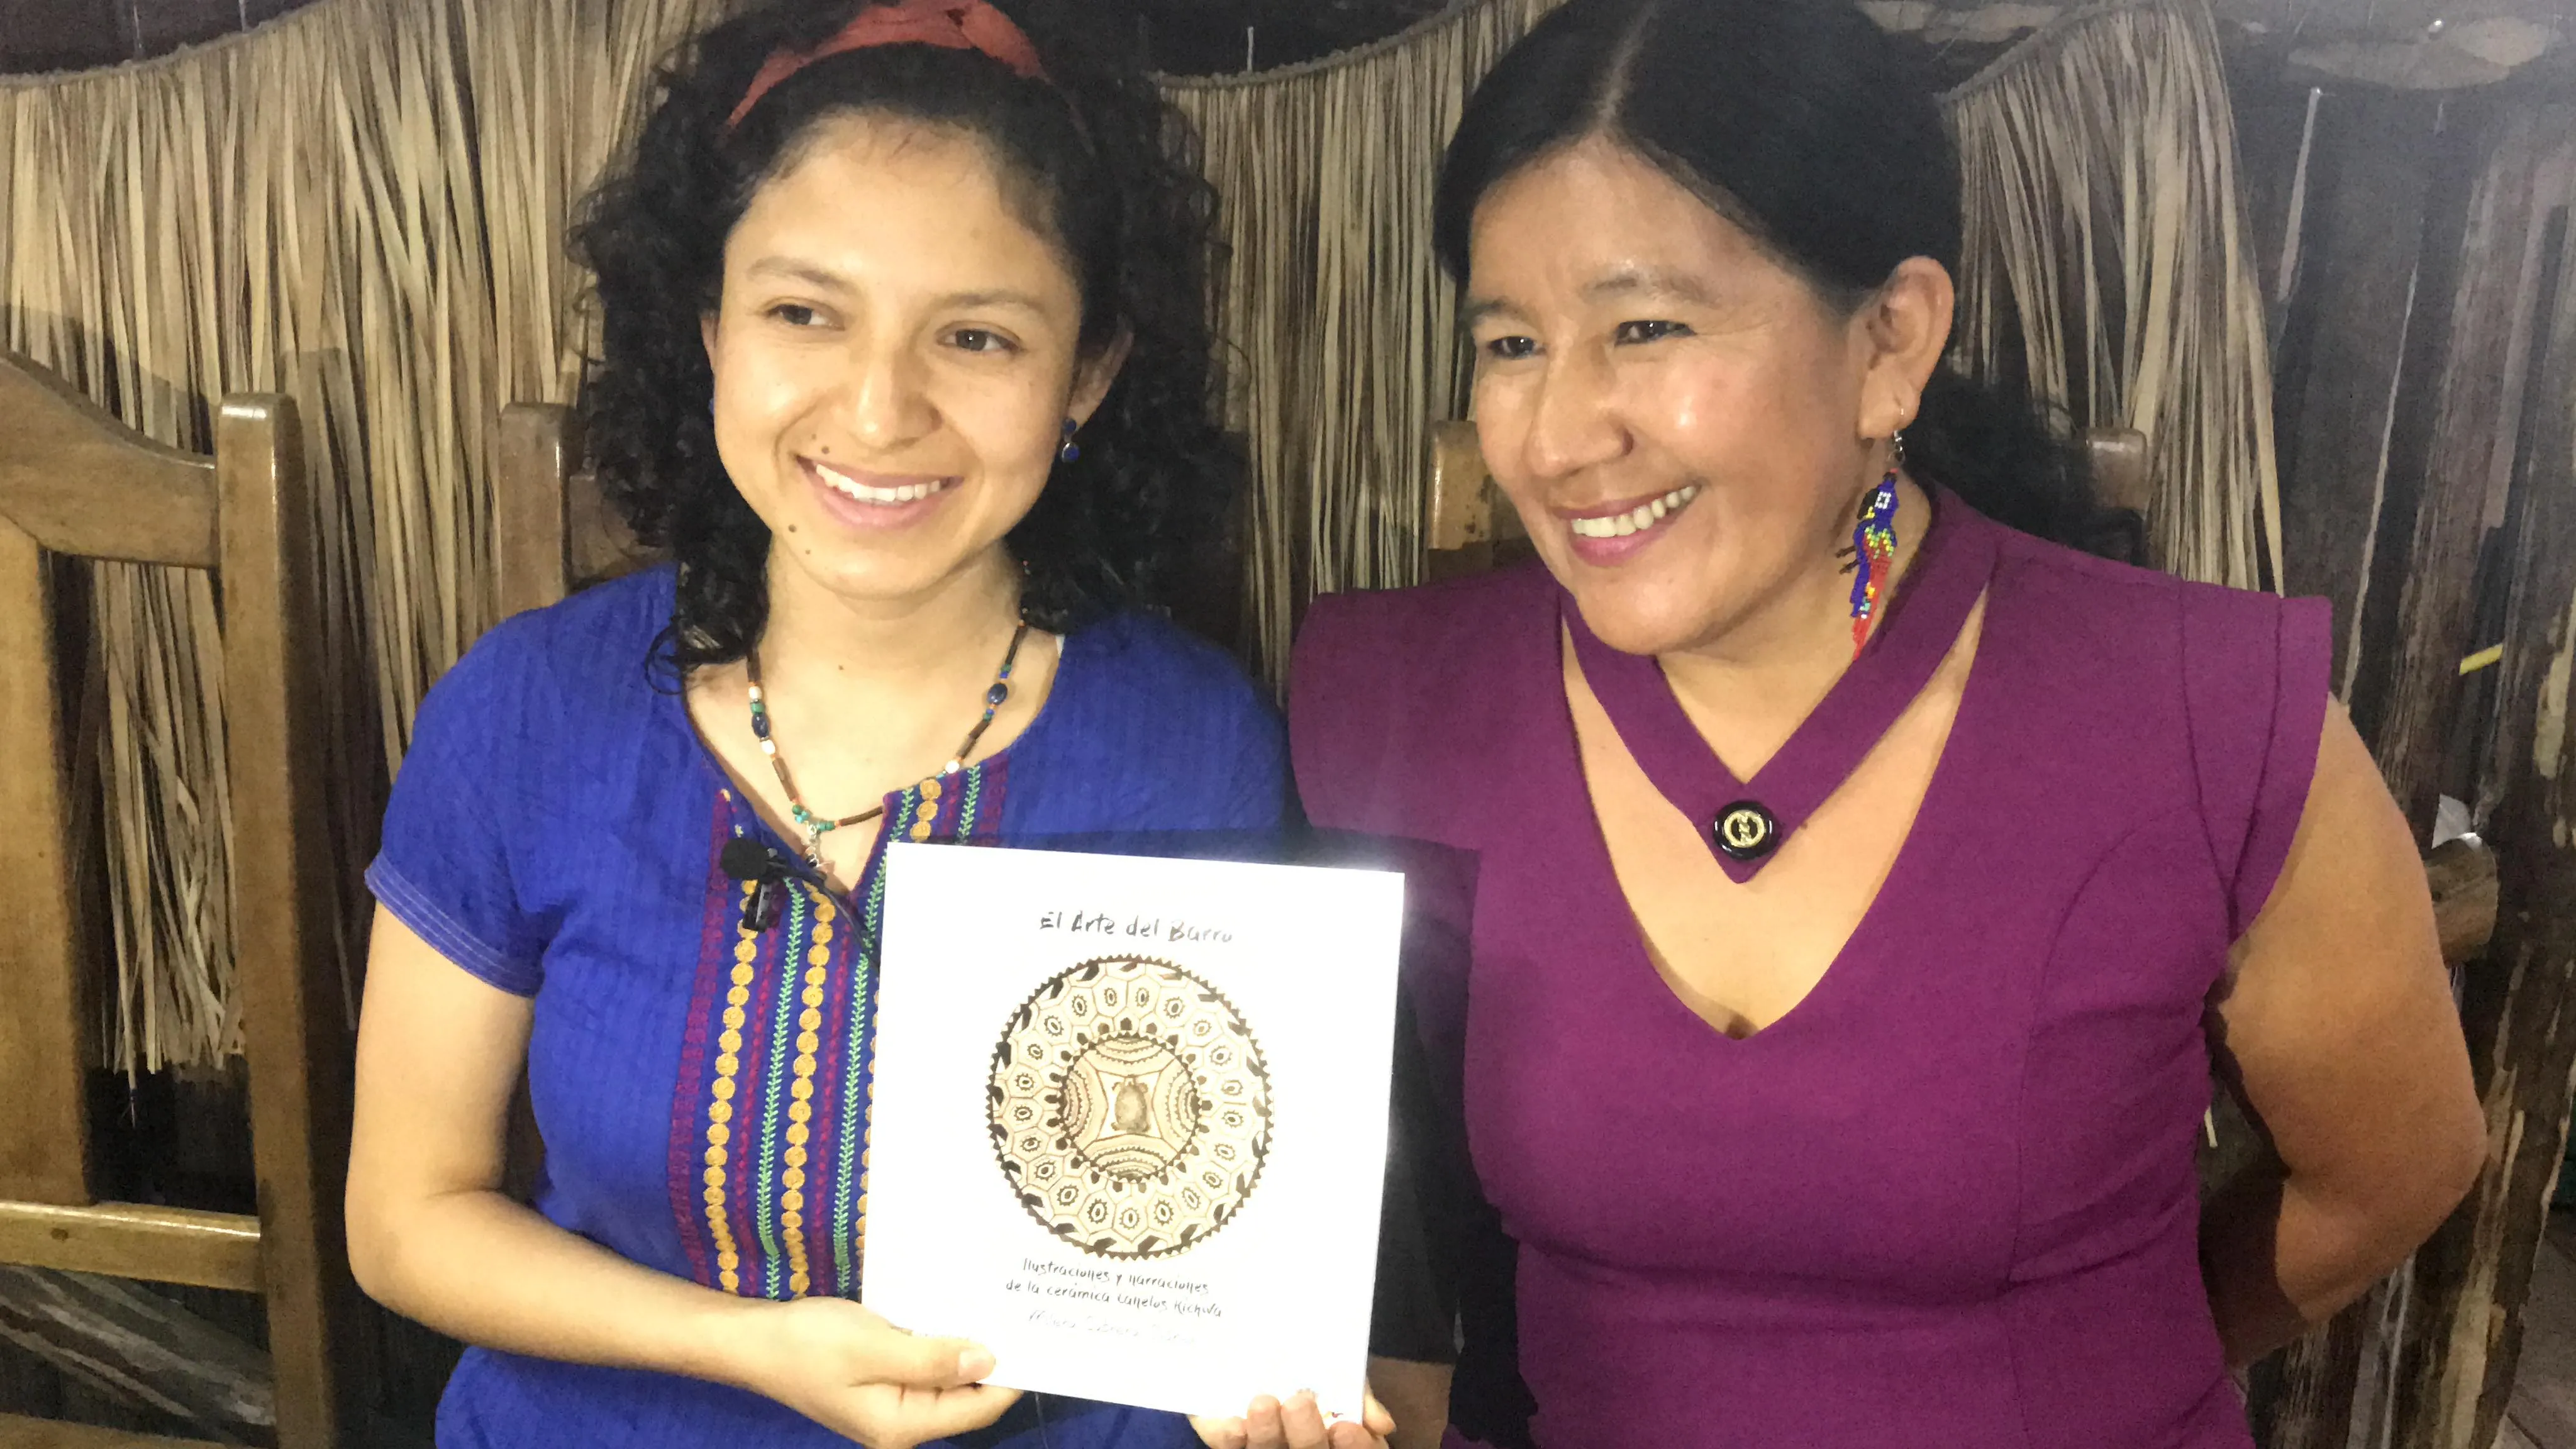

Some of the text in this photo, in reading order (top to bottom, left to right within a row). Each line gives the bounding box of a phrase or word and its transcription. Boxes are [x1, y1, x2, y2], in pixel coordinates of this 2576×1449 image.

[1040, 911, 1063, 930] El
[1071, 910, 1115, 935] Arte
[1126, 915, 1160, 938] del
[1006, 1279, 1021, 1291] de
[1028, 1280, 1040, 1294] la
[1116, 1274, 1123, 1286] y
